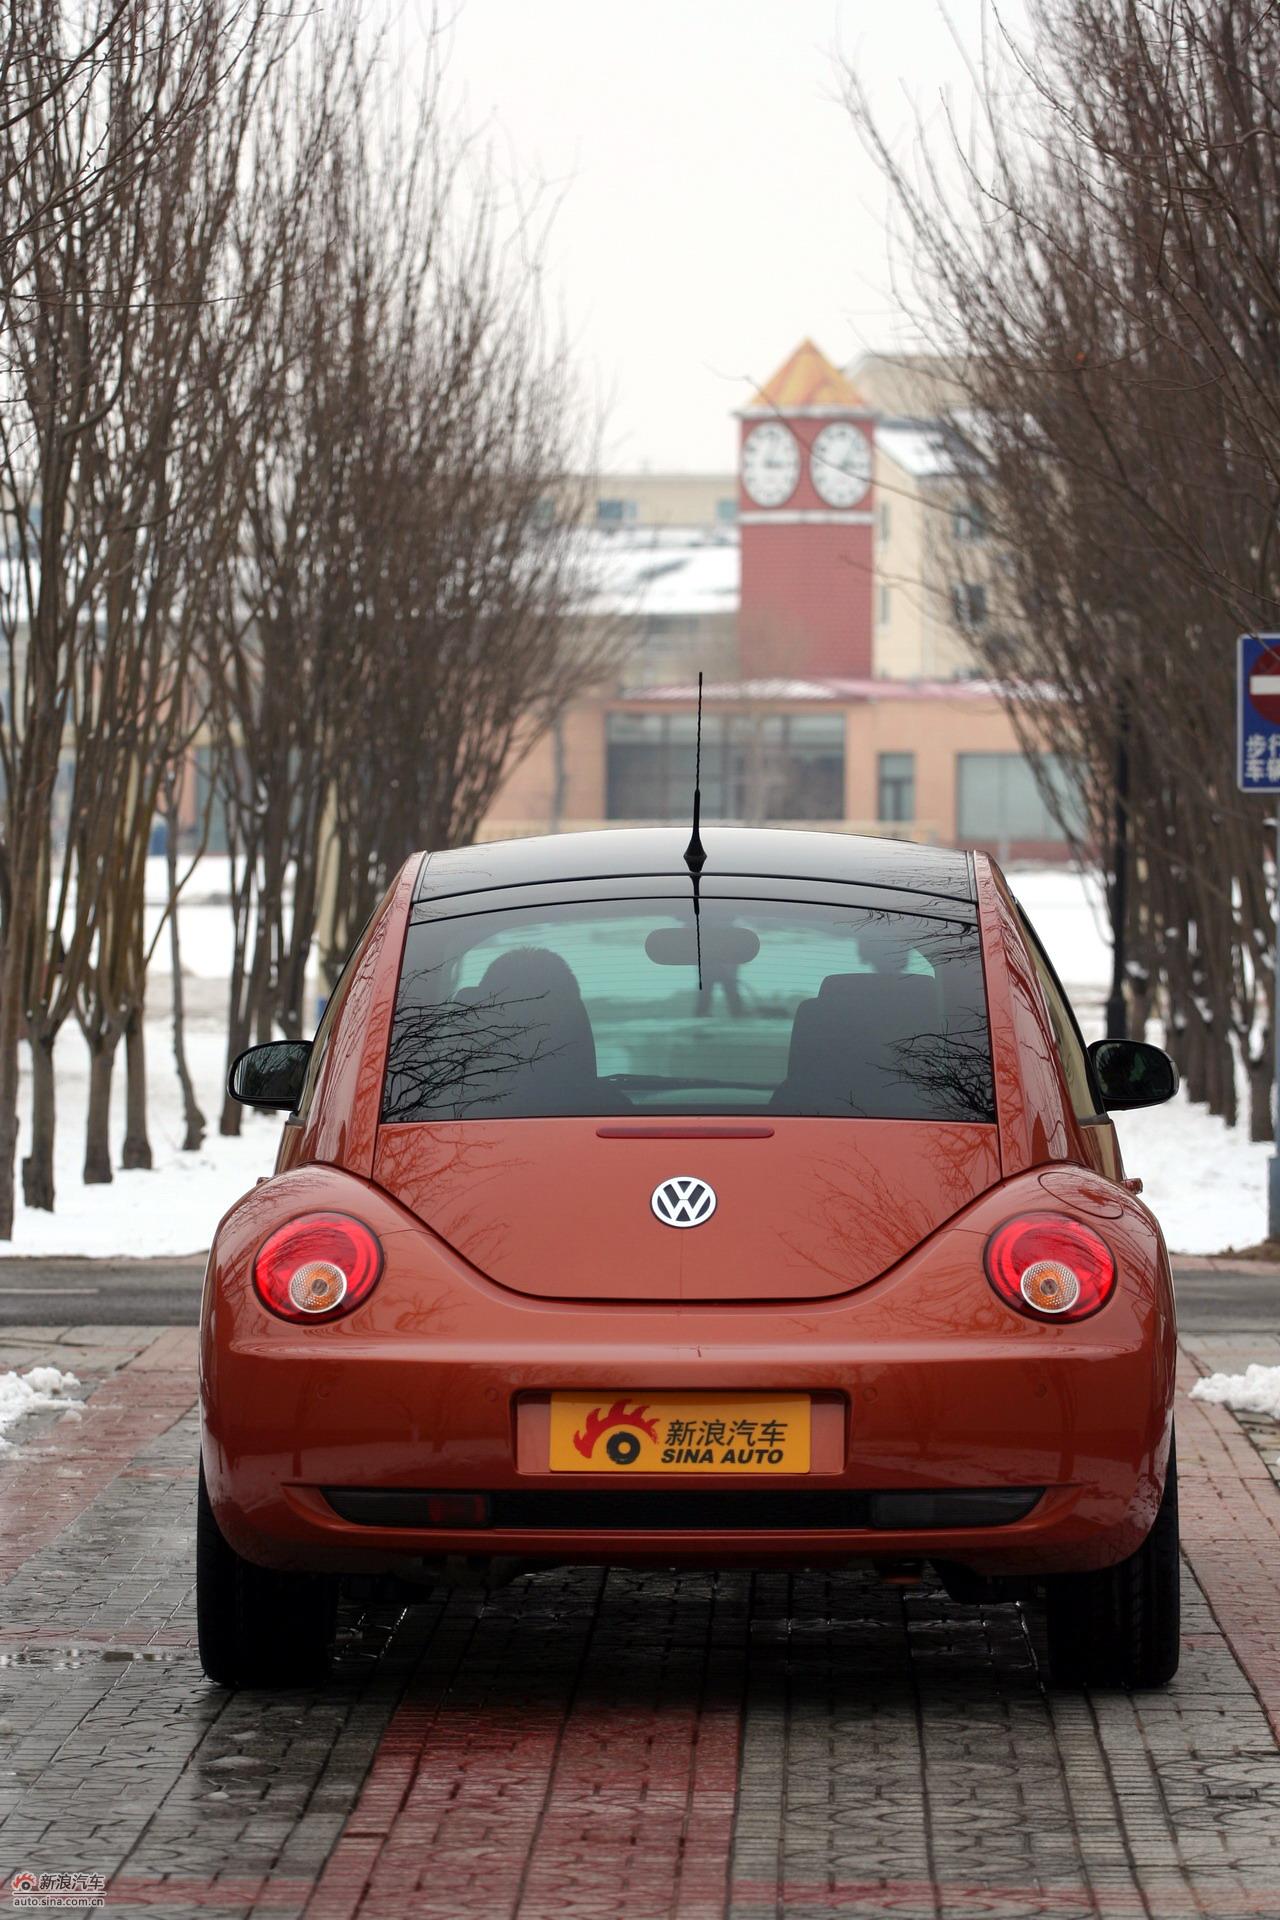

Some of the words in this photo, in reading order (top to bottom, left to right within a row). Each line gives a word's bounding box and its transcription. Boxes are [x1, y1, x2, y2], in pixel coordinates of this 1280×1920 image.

[654, 1178, 714, 1225] VW
[664, 1419, 788, 1447] 新浪汽车
[661, 1448, 713, 1464] SINA
[720, 1449, 783, 1464] AUTO
